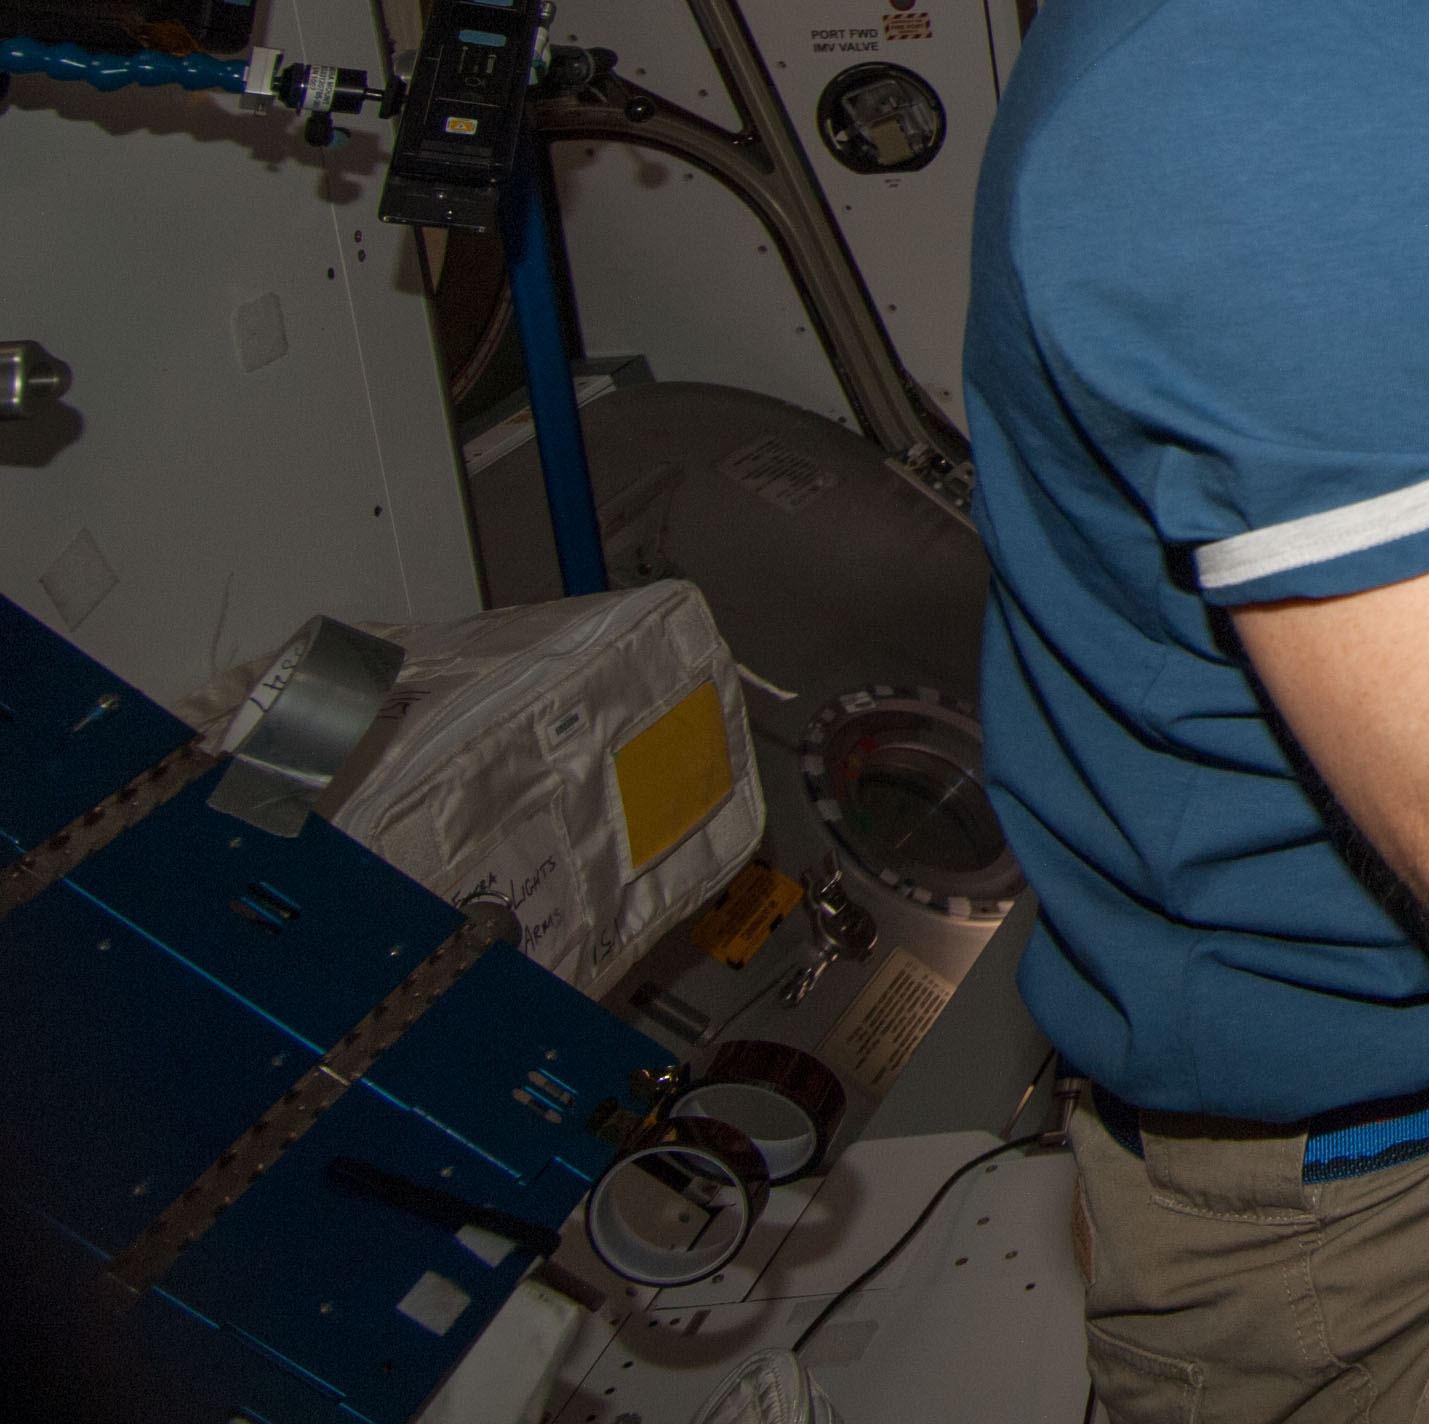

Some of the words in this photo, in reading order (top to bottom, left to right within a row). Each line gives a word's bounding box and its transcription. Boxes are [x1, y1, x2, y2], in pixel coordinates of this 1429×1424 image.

[811, 30, 844, 40] PORT
[849, 28, 878, 39] FWD
[813, 43, 834, 53] IMV
[838, 41, 879, 53] VALVE
[510, 855, 557, 910] LIGHTS
